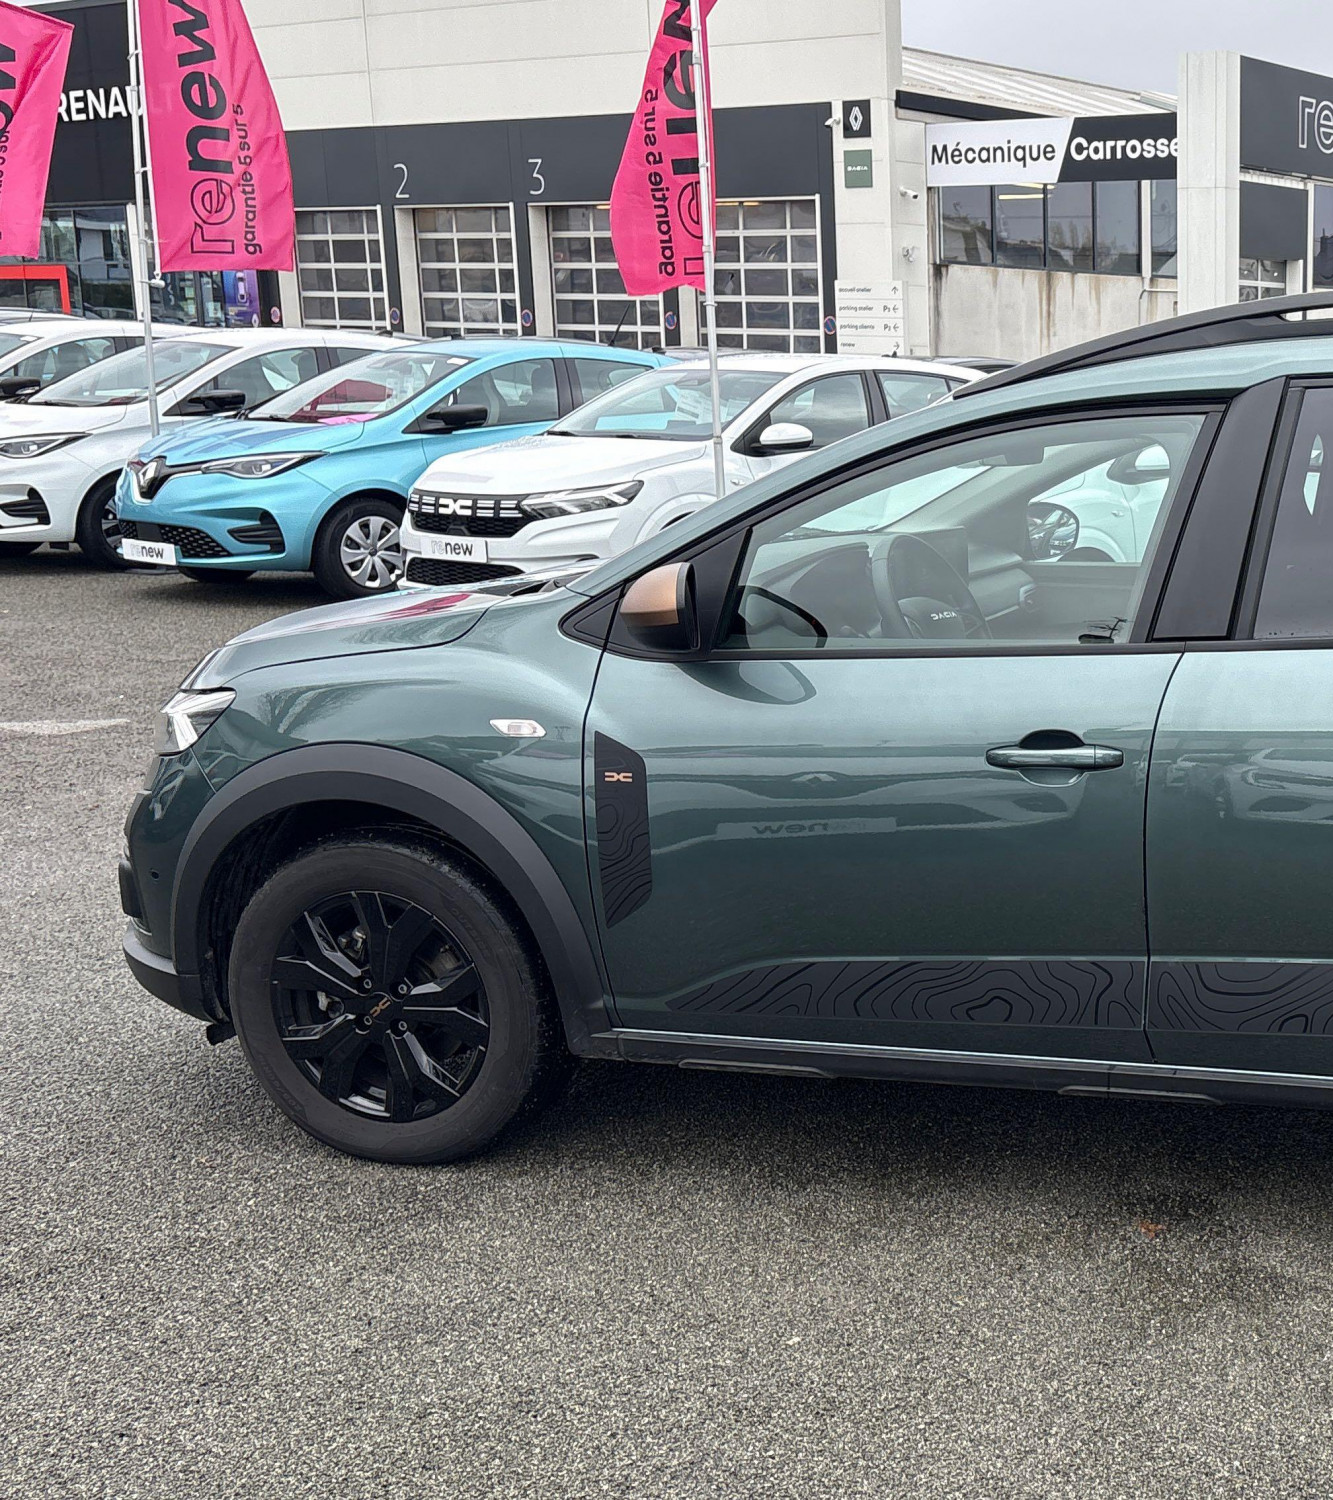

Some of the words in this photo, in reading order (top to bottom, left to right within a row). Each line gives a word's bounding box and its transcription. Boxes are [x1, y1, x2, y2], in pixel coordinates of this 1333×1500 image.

[232, 104, 244, 116] 5
[168, 0, 235, 254] renew
[235, 118, 251, 151] sur
[237, 155, 252, 166] 5
[931, 139, 1057, 168] Mécanique
[393, 163, 410, 199] 2
[527, 158, 545, 195] 3
[238, 170, 262, 255] garantie
[430, 540, 474, 557] renew
